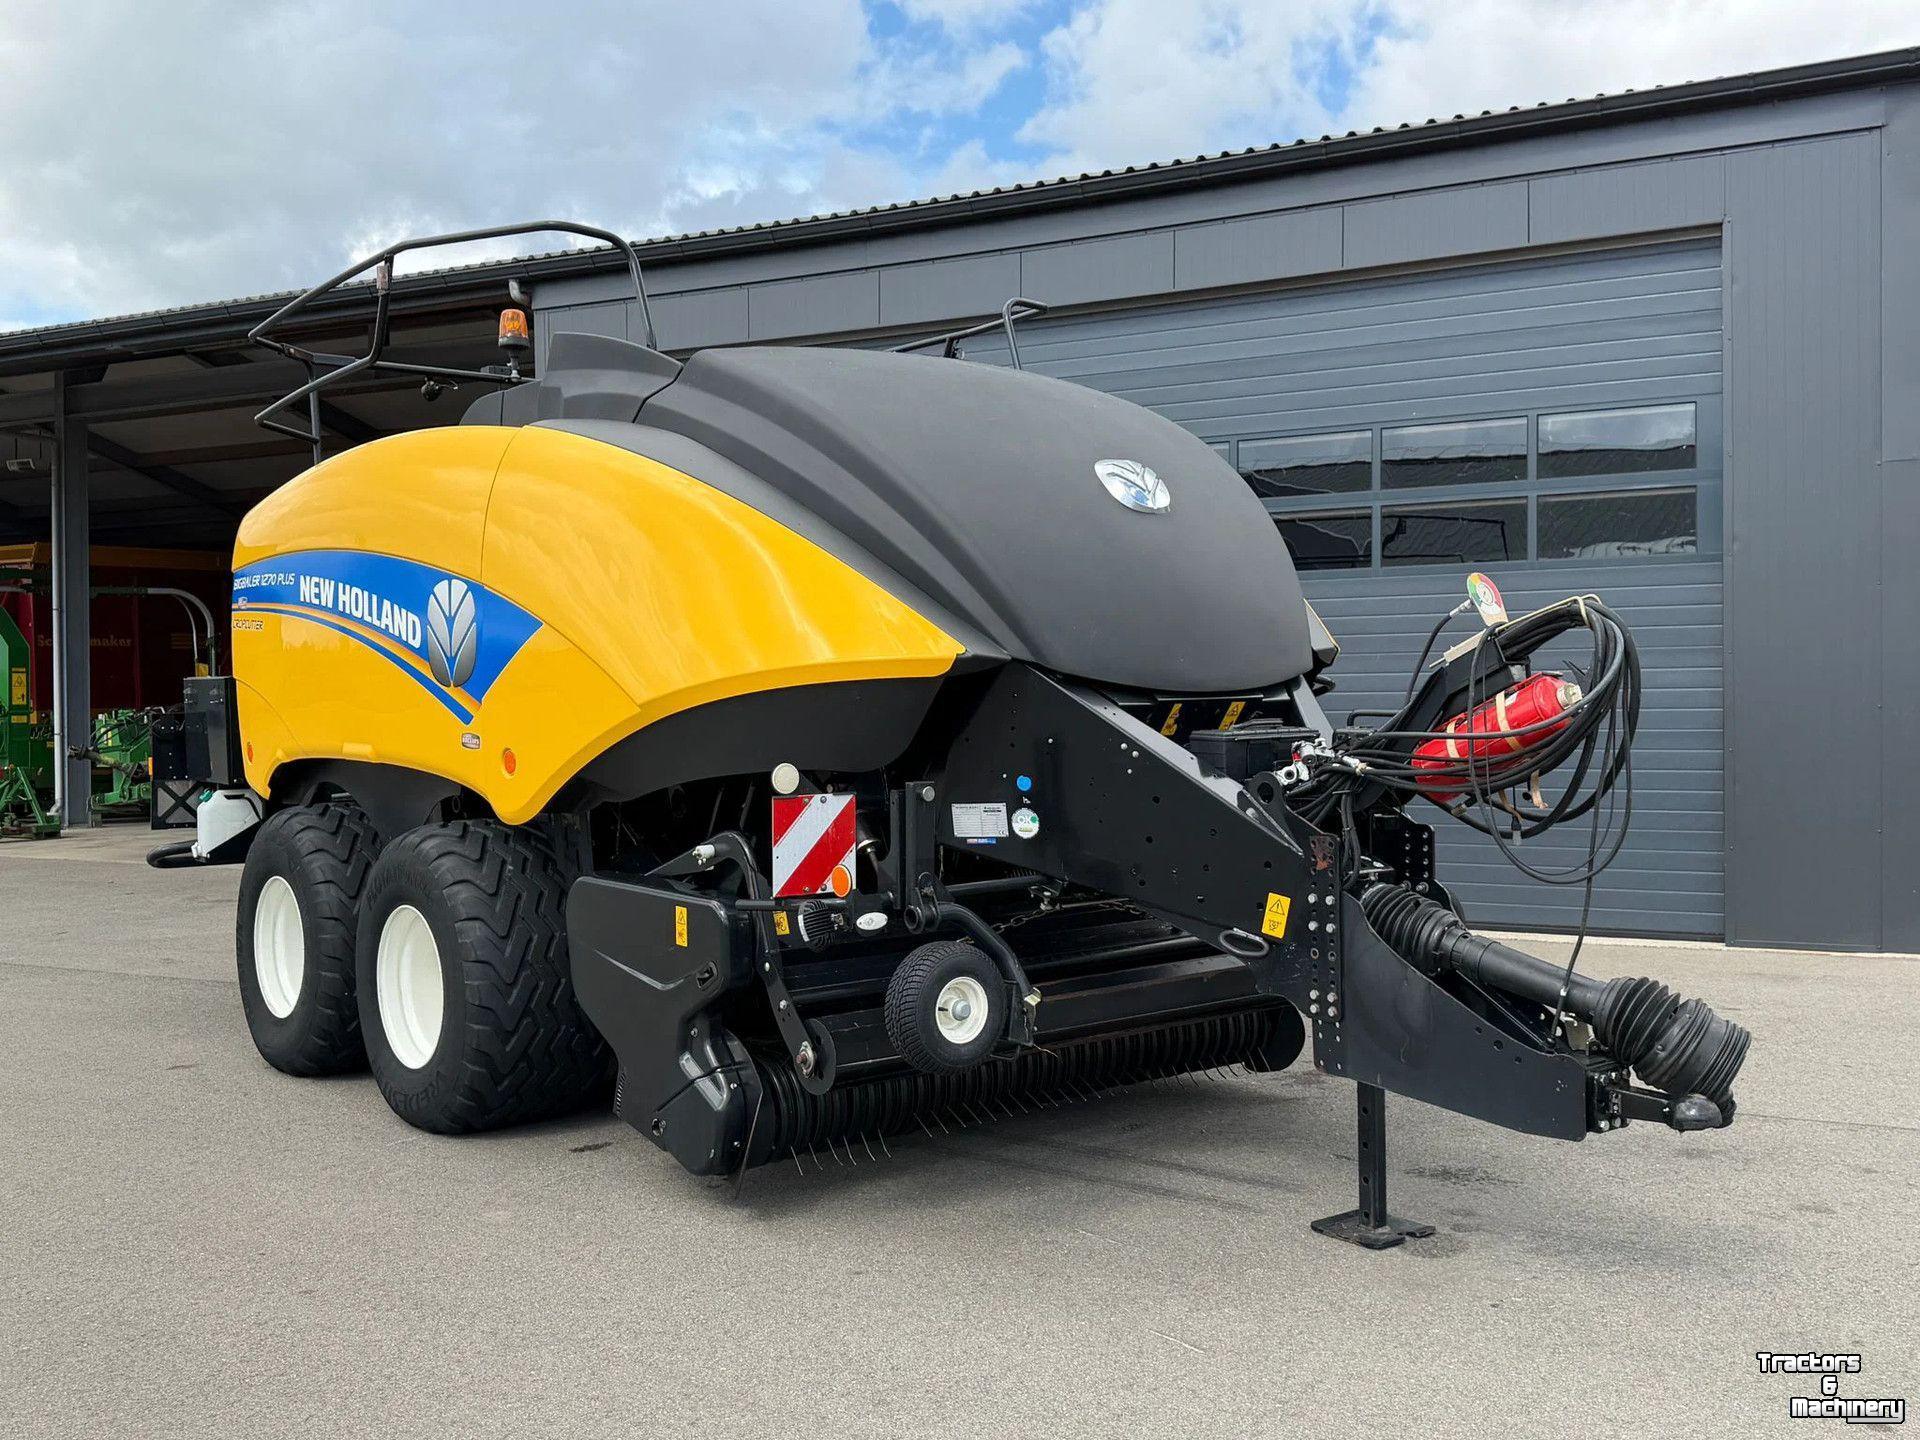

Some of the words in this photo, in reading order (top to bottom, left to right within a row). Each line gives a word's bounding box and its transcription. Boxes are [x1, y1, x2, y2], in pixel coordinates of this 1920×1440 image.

[277, 572, 296, 586] PLUS
[300, 575, 335, 609] NEW
[338, 582, 422, 649] HOLLAND
